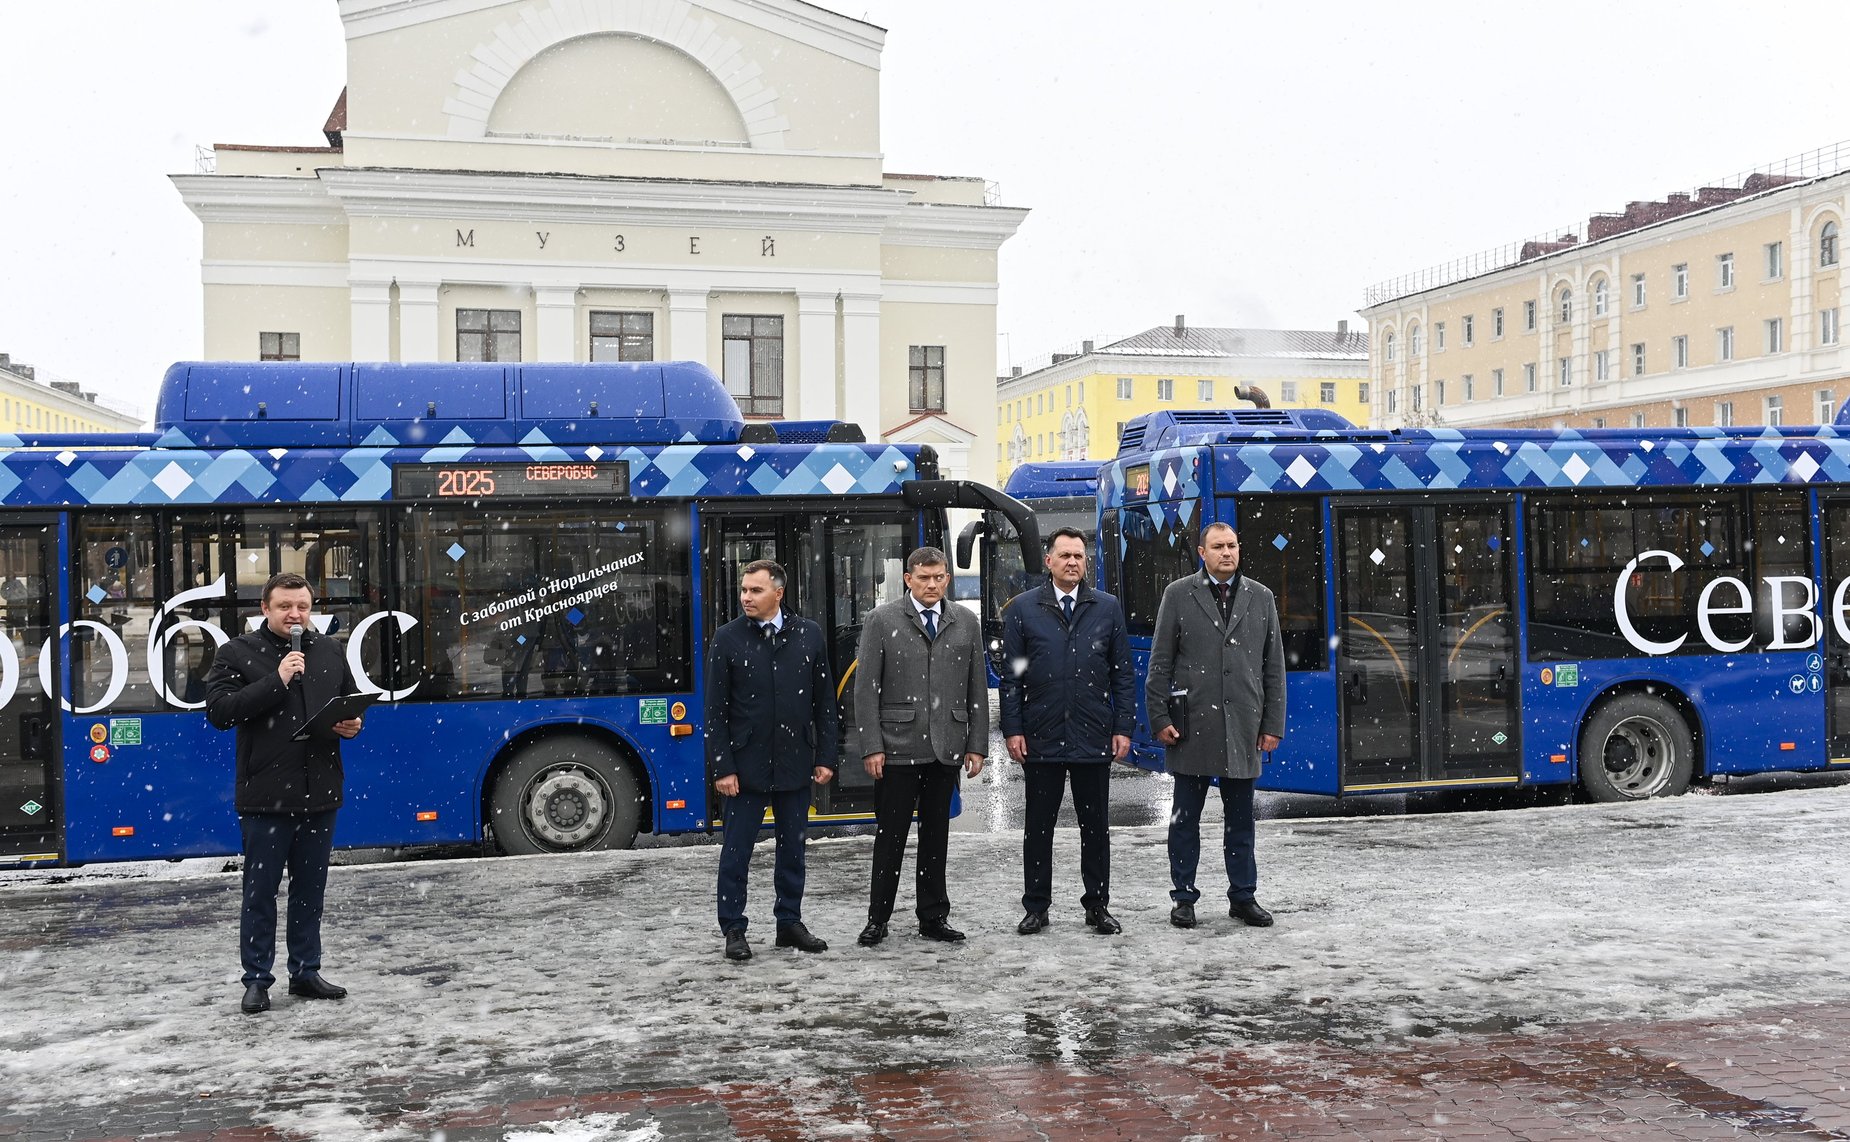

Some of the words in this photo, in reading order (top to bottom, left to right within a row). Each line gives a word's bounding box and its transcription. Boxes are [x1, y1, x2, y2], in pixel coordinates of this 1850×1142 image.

[456, 228, 776, 257] МУЗЕЙ
[438, 470, 495, 496] 2025
[526, 465, 599, 481] СЕВЕРОБУС
[460, 612, 470, 626] С
[472, 588, 537, 623] заботой
[539, 586, 548, 598] о
[549, 550, 646, 594] Норильчанах
[500, 616, 523, 631] от
[524, 580, 619, 624] Красноярцев
